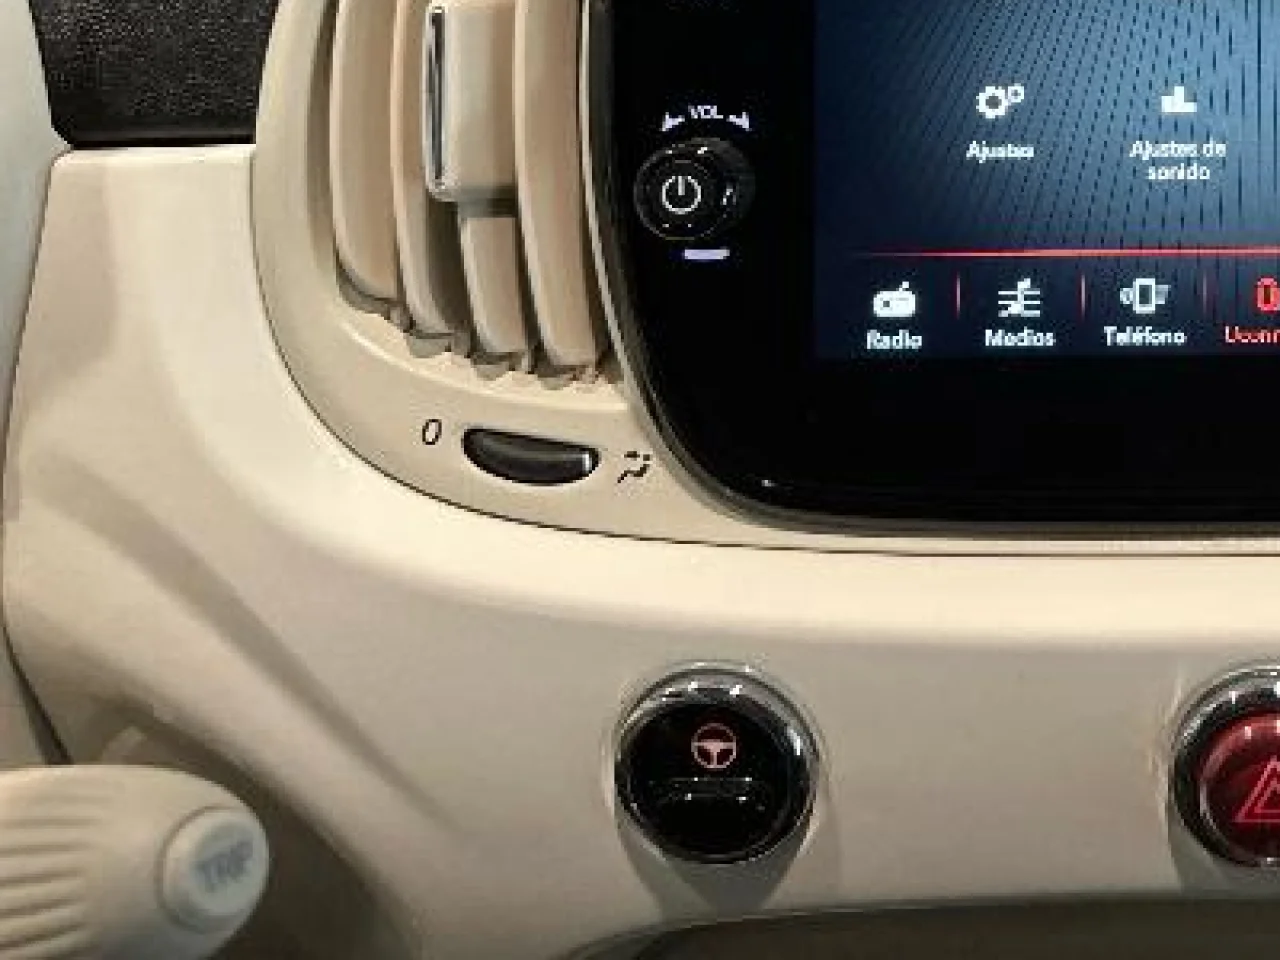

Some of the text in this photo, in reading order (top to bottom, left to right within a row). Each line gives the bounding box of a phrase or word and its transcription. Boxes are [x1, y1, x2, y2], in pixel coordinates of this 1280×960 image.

[688, 104, 724, 119] VOL
[966, 140, 1035, 164] Ajustes
[1130, 138, 1228, 162] Ajustes de
[1148, 162, 1212, 180] sonido
[866, 328, 923, 350] Radio
[984, 327, 1056, 348] Medios
[1103, 325, 1187, 347] Teléfono
